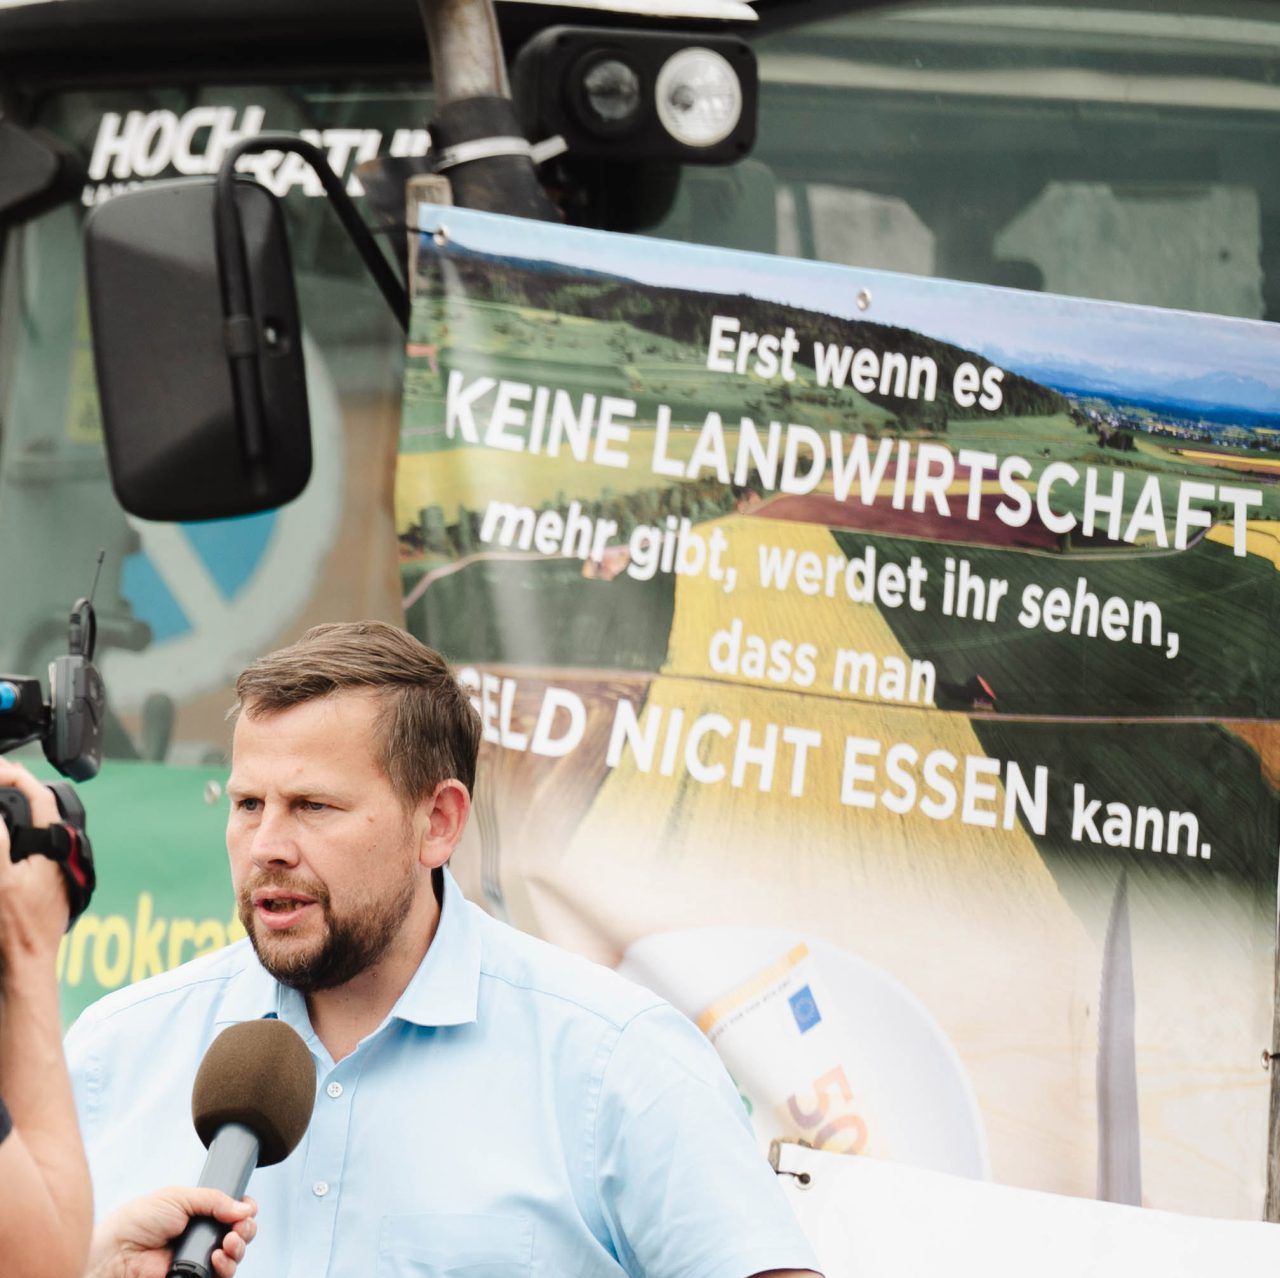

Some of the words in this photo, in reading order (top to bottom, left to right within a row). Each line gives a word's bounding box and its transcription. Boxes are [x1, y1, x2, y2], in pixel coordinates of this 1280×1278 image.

[707, 316, 799, 381] Erst
[814, 340, 937, 401] wenn
[953, 363, 1004, 411] es
[445, 369, 637, 469] KEINE
[651, 404, 1264, 558] LANDWIRTSCHAFT
[480, 498, 617, 562] mehr
[627, 516, 738, 594] gibt,
[758, 544, 928, 612] werdet
[943, 558, 1008, 623] ihr
[1021, 577, 1180, 659] sehen,
[708, 617, 817, 688] dass
[833, 648, 936, 706] man
[605, 698, 822, 798] NICHT
[840, 736, 1048, 836] ESSEN
[1071, 785, 1212, 860] kann.
